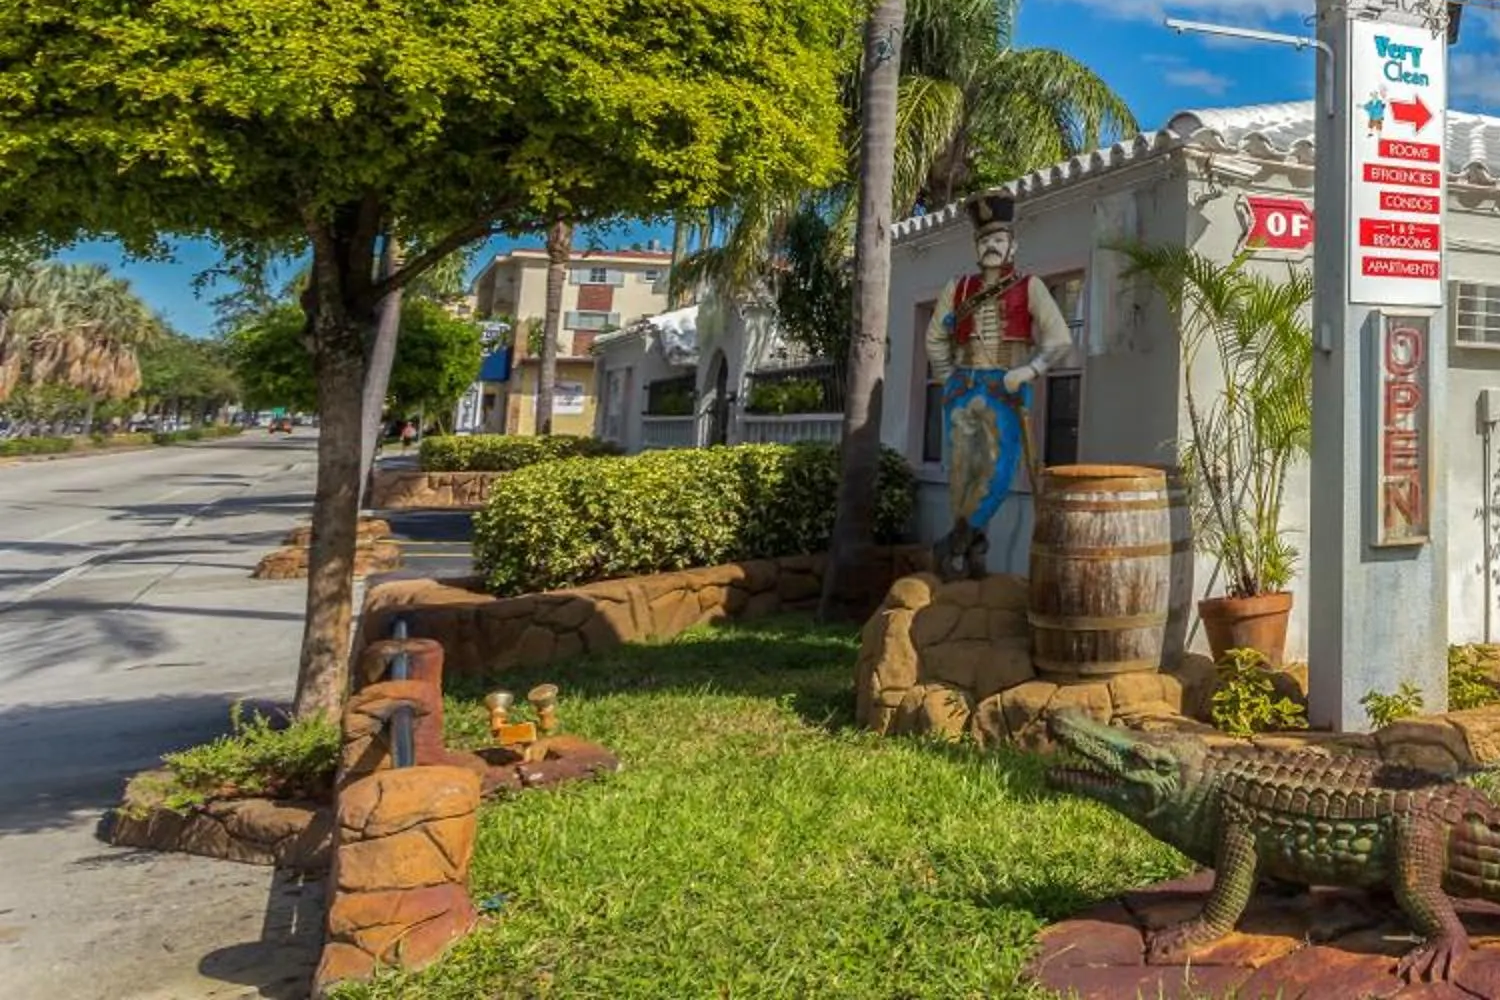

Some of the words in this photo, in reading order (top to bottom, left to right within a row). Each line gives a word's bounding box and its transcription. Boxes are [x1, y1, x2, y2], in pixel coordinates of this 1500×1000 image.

[1384, 60, 1429, 86] Clean
[1389, 143, 1429, 159] ROOMS
[1371, 167, 1433, 185] EFFICIENCIES
[1386, 195, 1433, 211] CONDOS
[1373, 233, 1432, 249] BEDROOMS
[1367, 261, 1435, 276] APARTMENTS
[1384, 327, 1423, 529] OPEN
